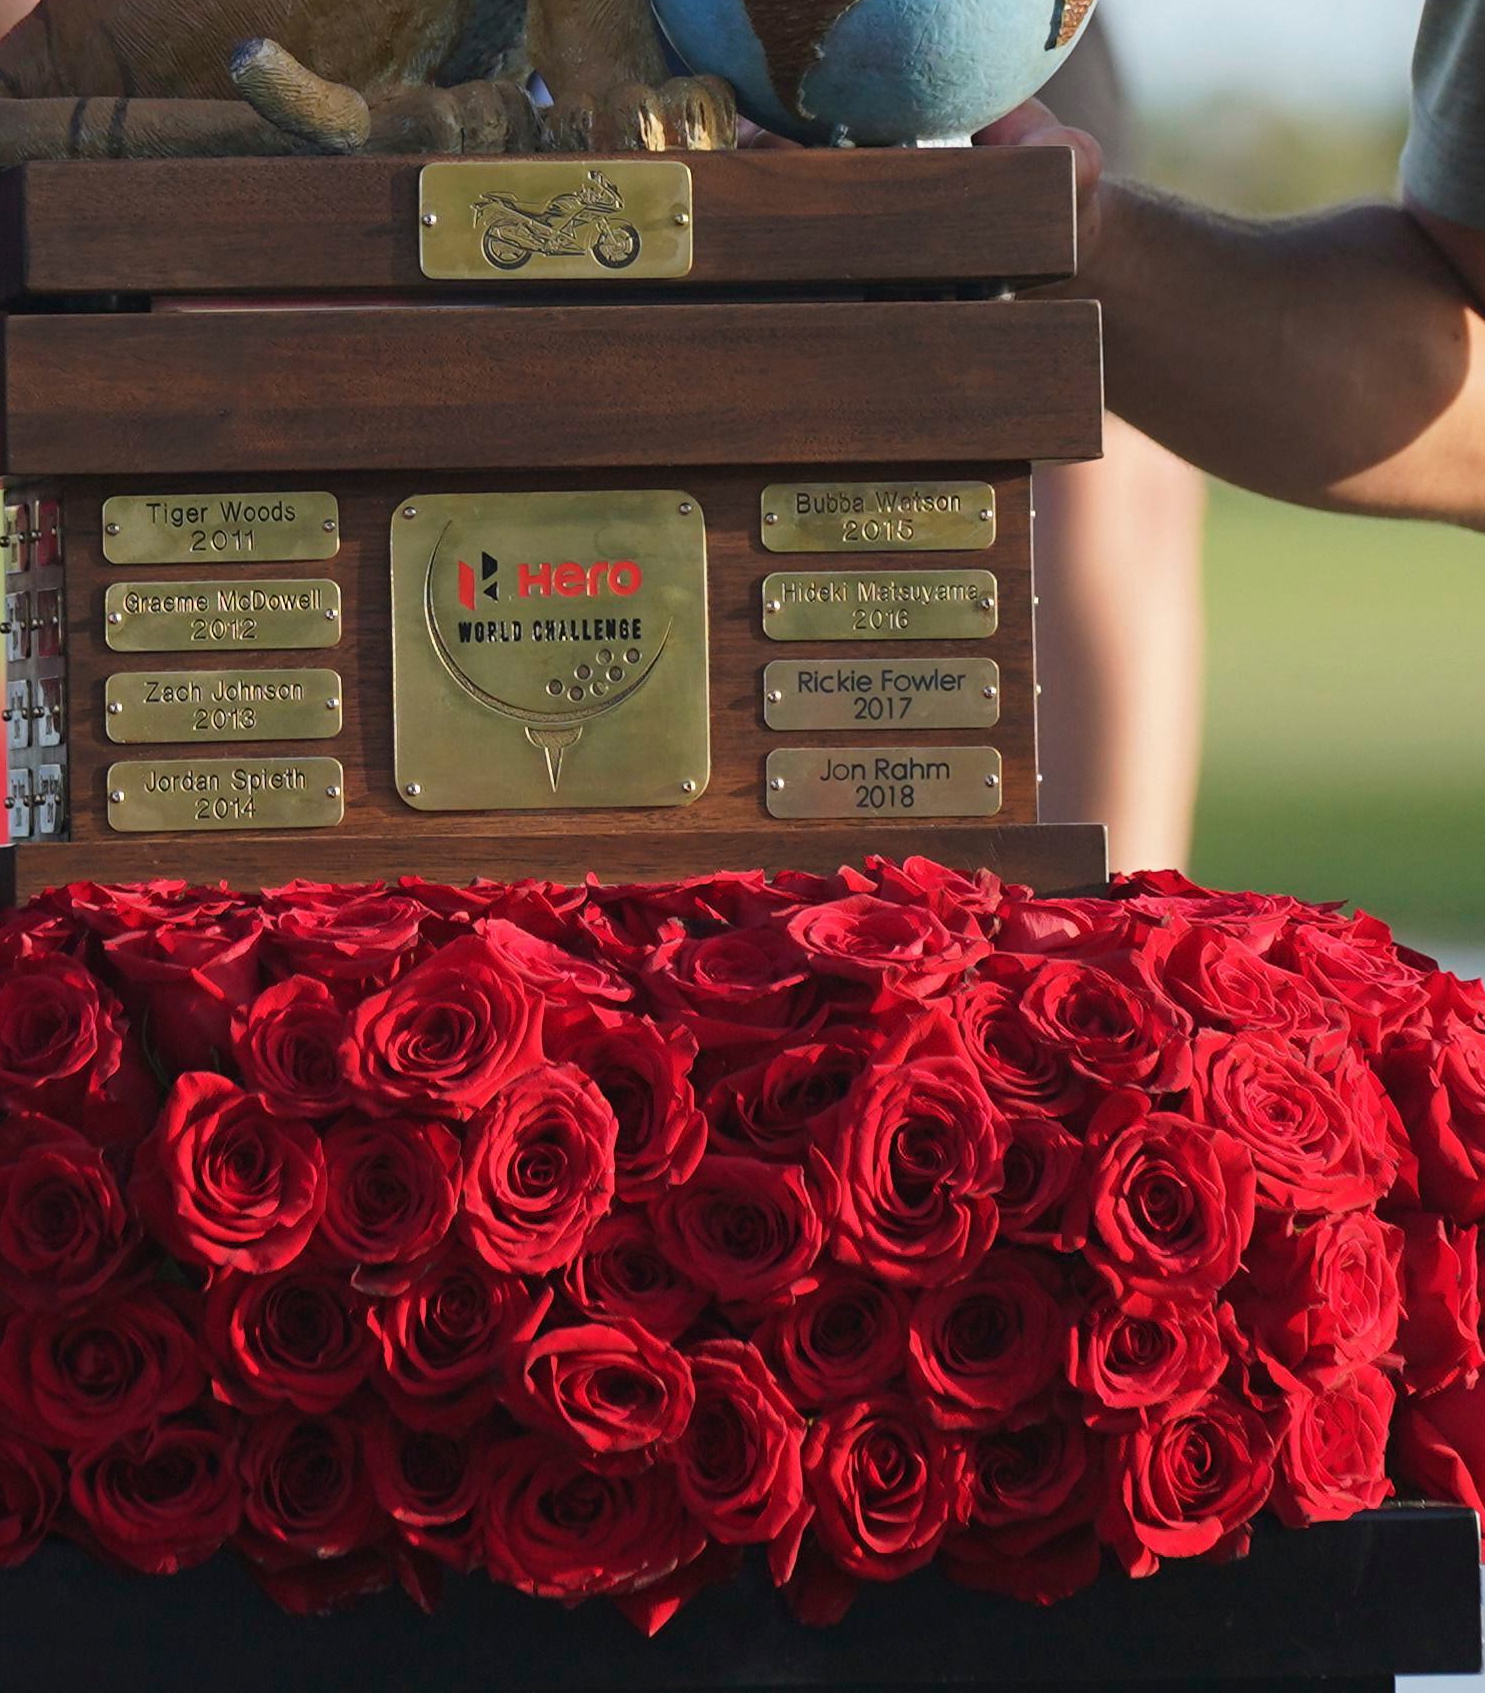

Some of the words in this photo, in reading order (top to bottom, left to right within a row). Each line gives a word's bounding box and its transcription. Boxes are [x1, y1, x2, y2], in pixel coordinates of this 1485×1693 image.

[146, 503, 208, 527] Tiger
[220, 501, 296, 523] Woods
[795, 492, 864, 514] Bubba
[875, 491, 961, 513] Watson
[190, 530, 255, 552] 2011
[842, 519, 914, 542] 2015
[517, 560, 643, 597] Hero
[123, 591, 209, 614] Graeme
[217, 589, 321, 612] McDowell
[781, 582, 847, 603] Hideki
[857, 581, 978, 605] Matsuyama
[190, 618, 257, 641] 2012
[458, 621, 522, 643] WORLD
[532, 618, 642, 641] CHALLENGE
[852, 609, 909, 631] 2016
[143, 681, 202, 704] Zach
[212, 680, 304, 702] Johnson
[798, 670, 873, 693] Rickie
[881, 669, 966, 692] Fowler
[192, 708, 257, 731] 2013
[854, 697, 913, 720] 2017
[144, 771, 220, 793] Jordan
[231, 768, 307, 794] Spieth
[820, 758, 866, 781] Jon
[874, 757, 950, 780] Rahm
[855, 785, 915, 808] 2018
[195, 797, 257, 821] 2014
